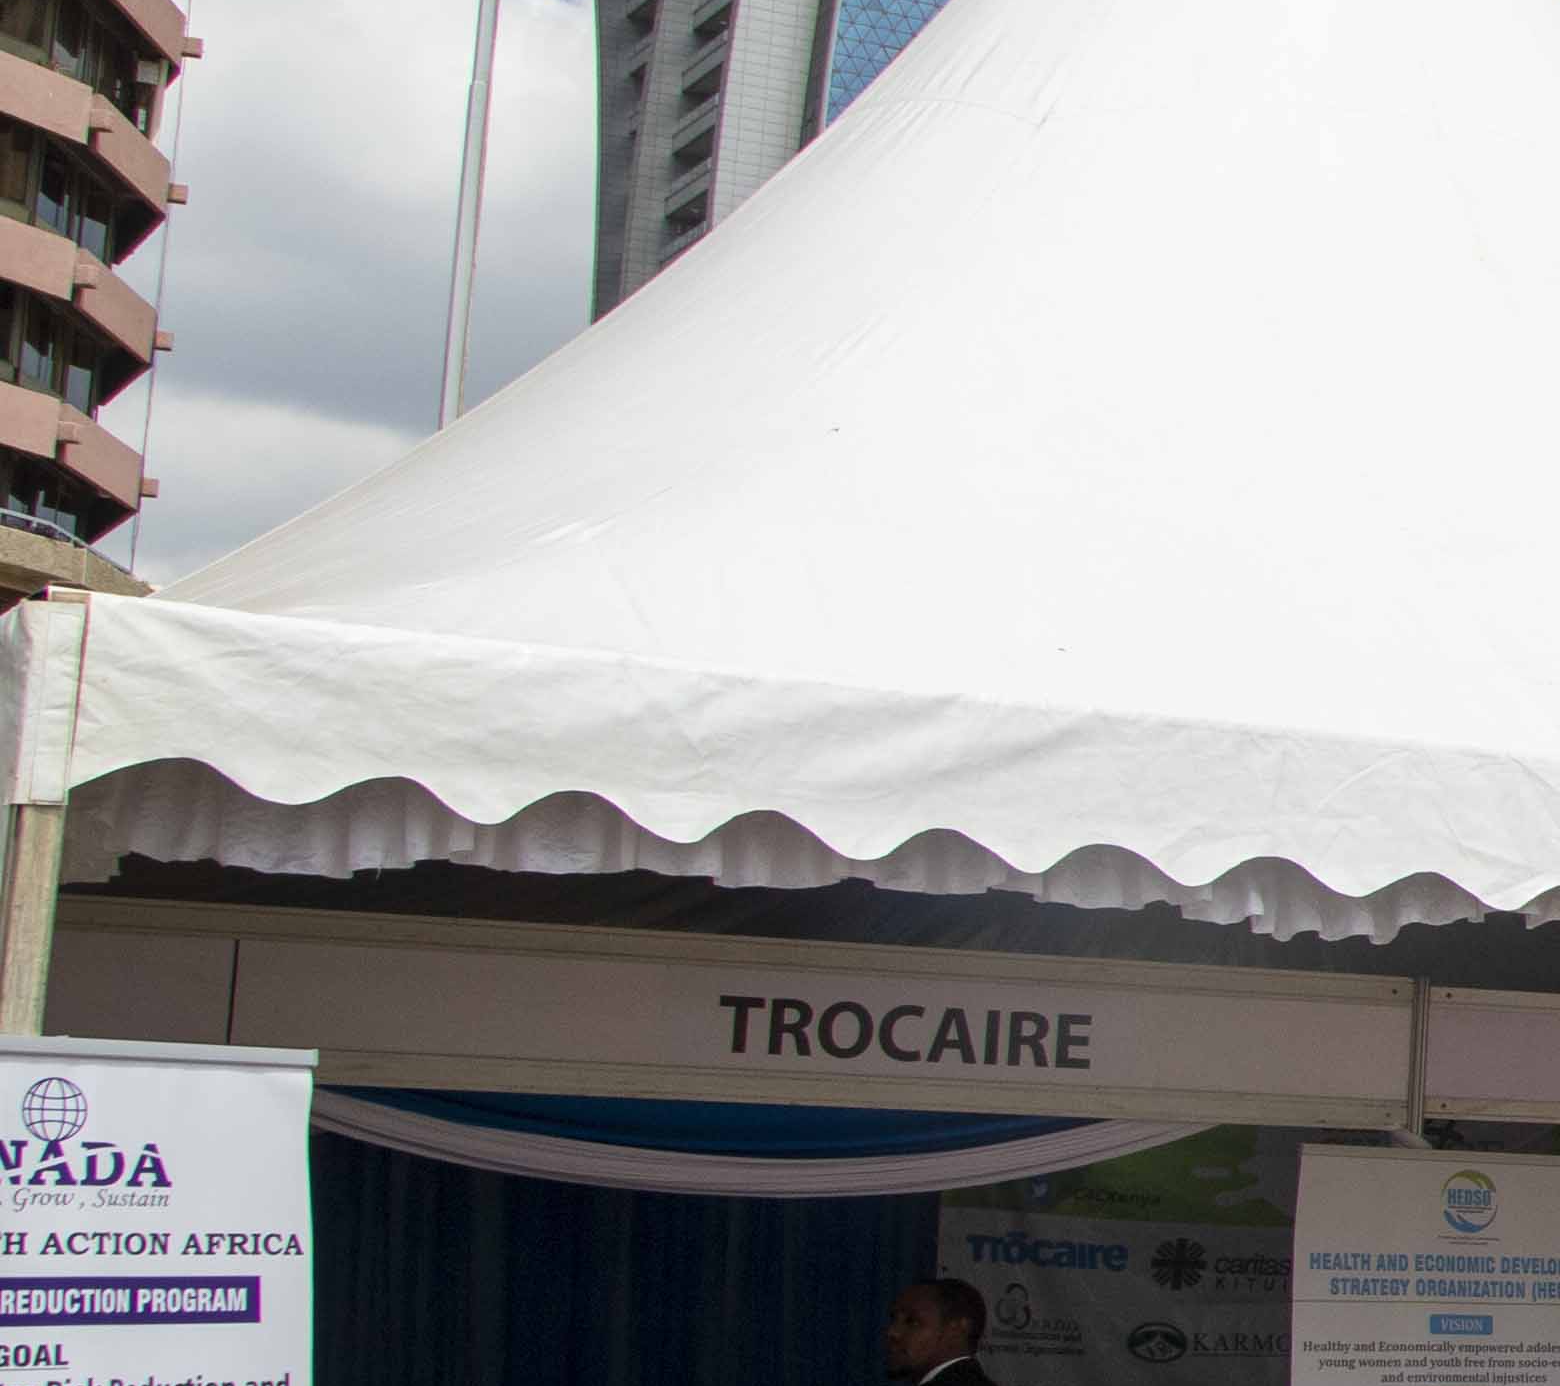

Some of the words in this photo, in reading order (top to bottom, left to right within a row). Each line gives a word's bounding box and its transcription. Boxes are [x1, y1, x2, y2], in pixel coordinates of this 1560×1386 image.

[719, 995, 1092, 1070] TROCAIRE
[13, 1188, 75, 1213] Grow
[91, 1189, 170, 1208] Sustain
[1448, 1189, 1491, 1206] HEDSO
[40, 1232, 171, 1255] ACTION
[181, 1233, 304, 1256] AFRICA
[1310, 1253, 1371, 1271] HEALTH
[1376, 1254, 1408, 1272] AND
[1415, 1254, 1495, 1274] ECONOMIC
[1330, 1277, 1410, 1296] STRATEGY
[1416, 1280, 1524, 1299] ORGANIZATION
[1, 1288, 130, 1315] REDUCTION
[136, 1287, 247, 1312] PROGRAM
[1440, 1317, 1483, 1332] VISION
